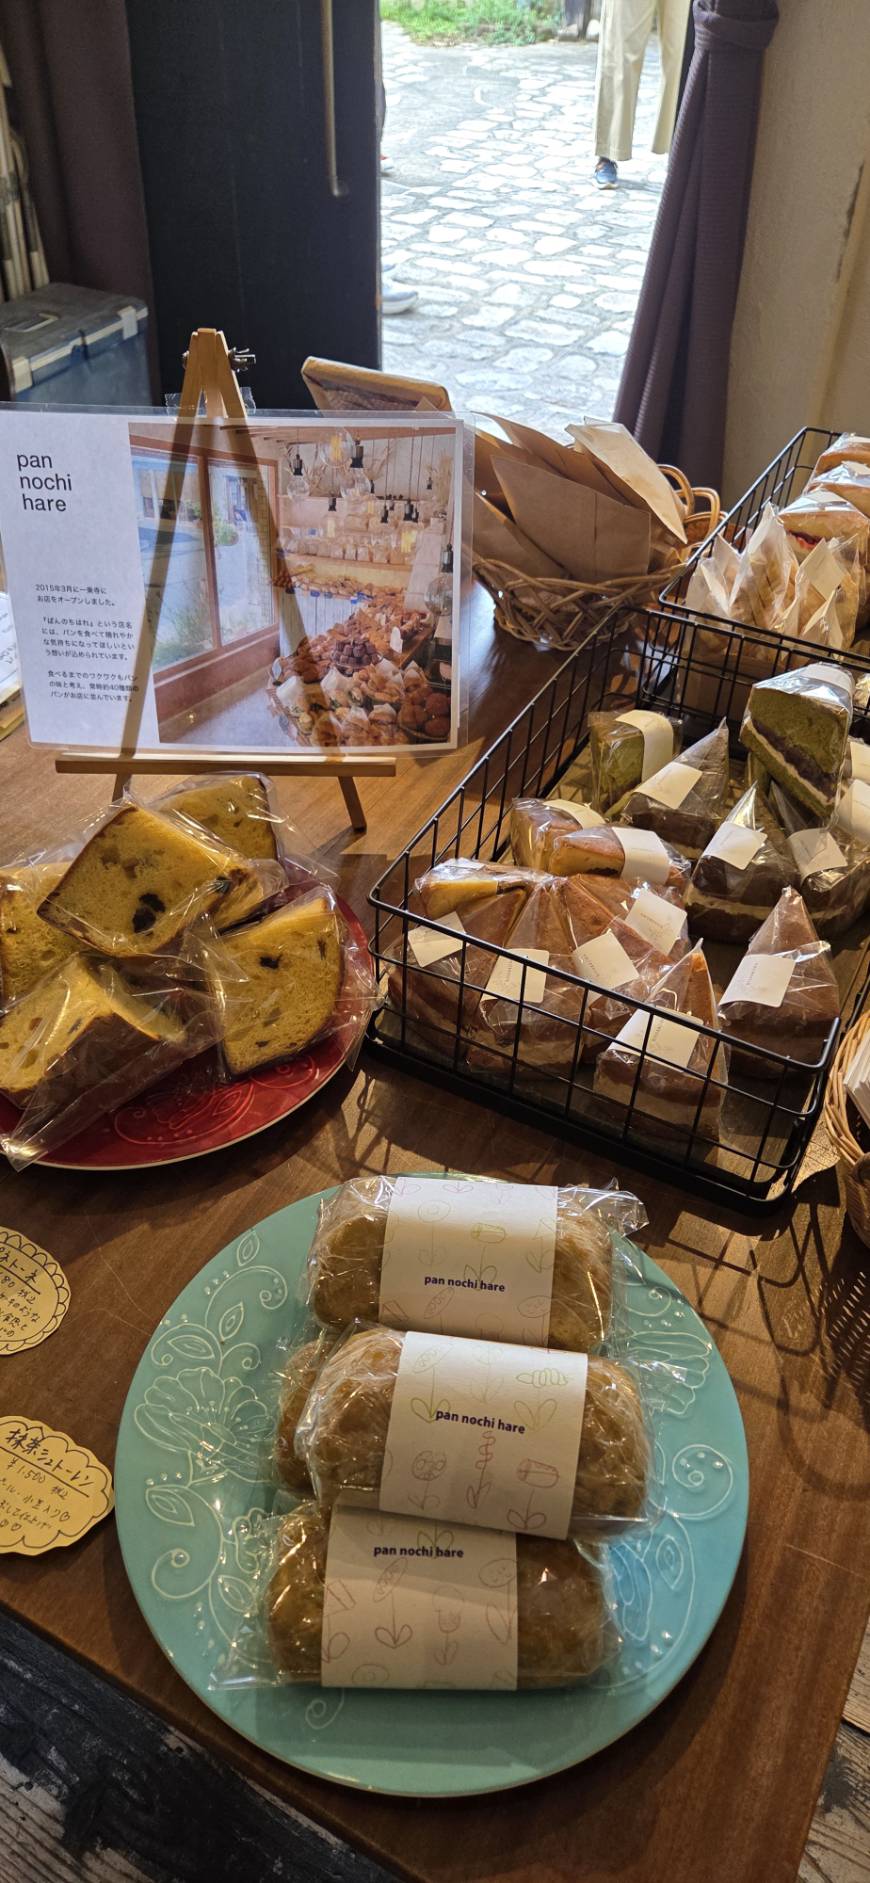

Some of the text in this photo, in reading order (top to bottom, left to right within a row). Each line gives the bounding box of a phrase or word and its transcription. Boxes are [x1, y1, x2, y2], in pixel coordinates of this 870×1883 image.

[17, 454, 53, 471] pan
[20, 473, 72, 491] nochi
[22, 493, 67, 512] hare
[37, 595, 115, 606] お店をオープンしました。
[424, 1275, 506, 1292] pan nochi hare
[435, 1410, 526, 1434] pan nochi hare
[5, 1429, 95, 1487] 抹茶シュトーレン
[373, 1546, 464, 1558] pan nochi hare
